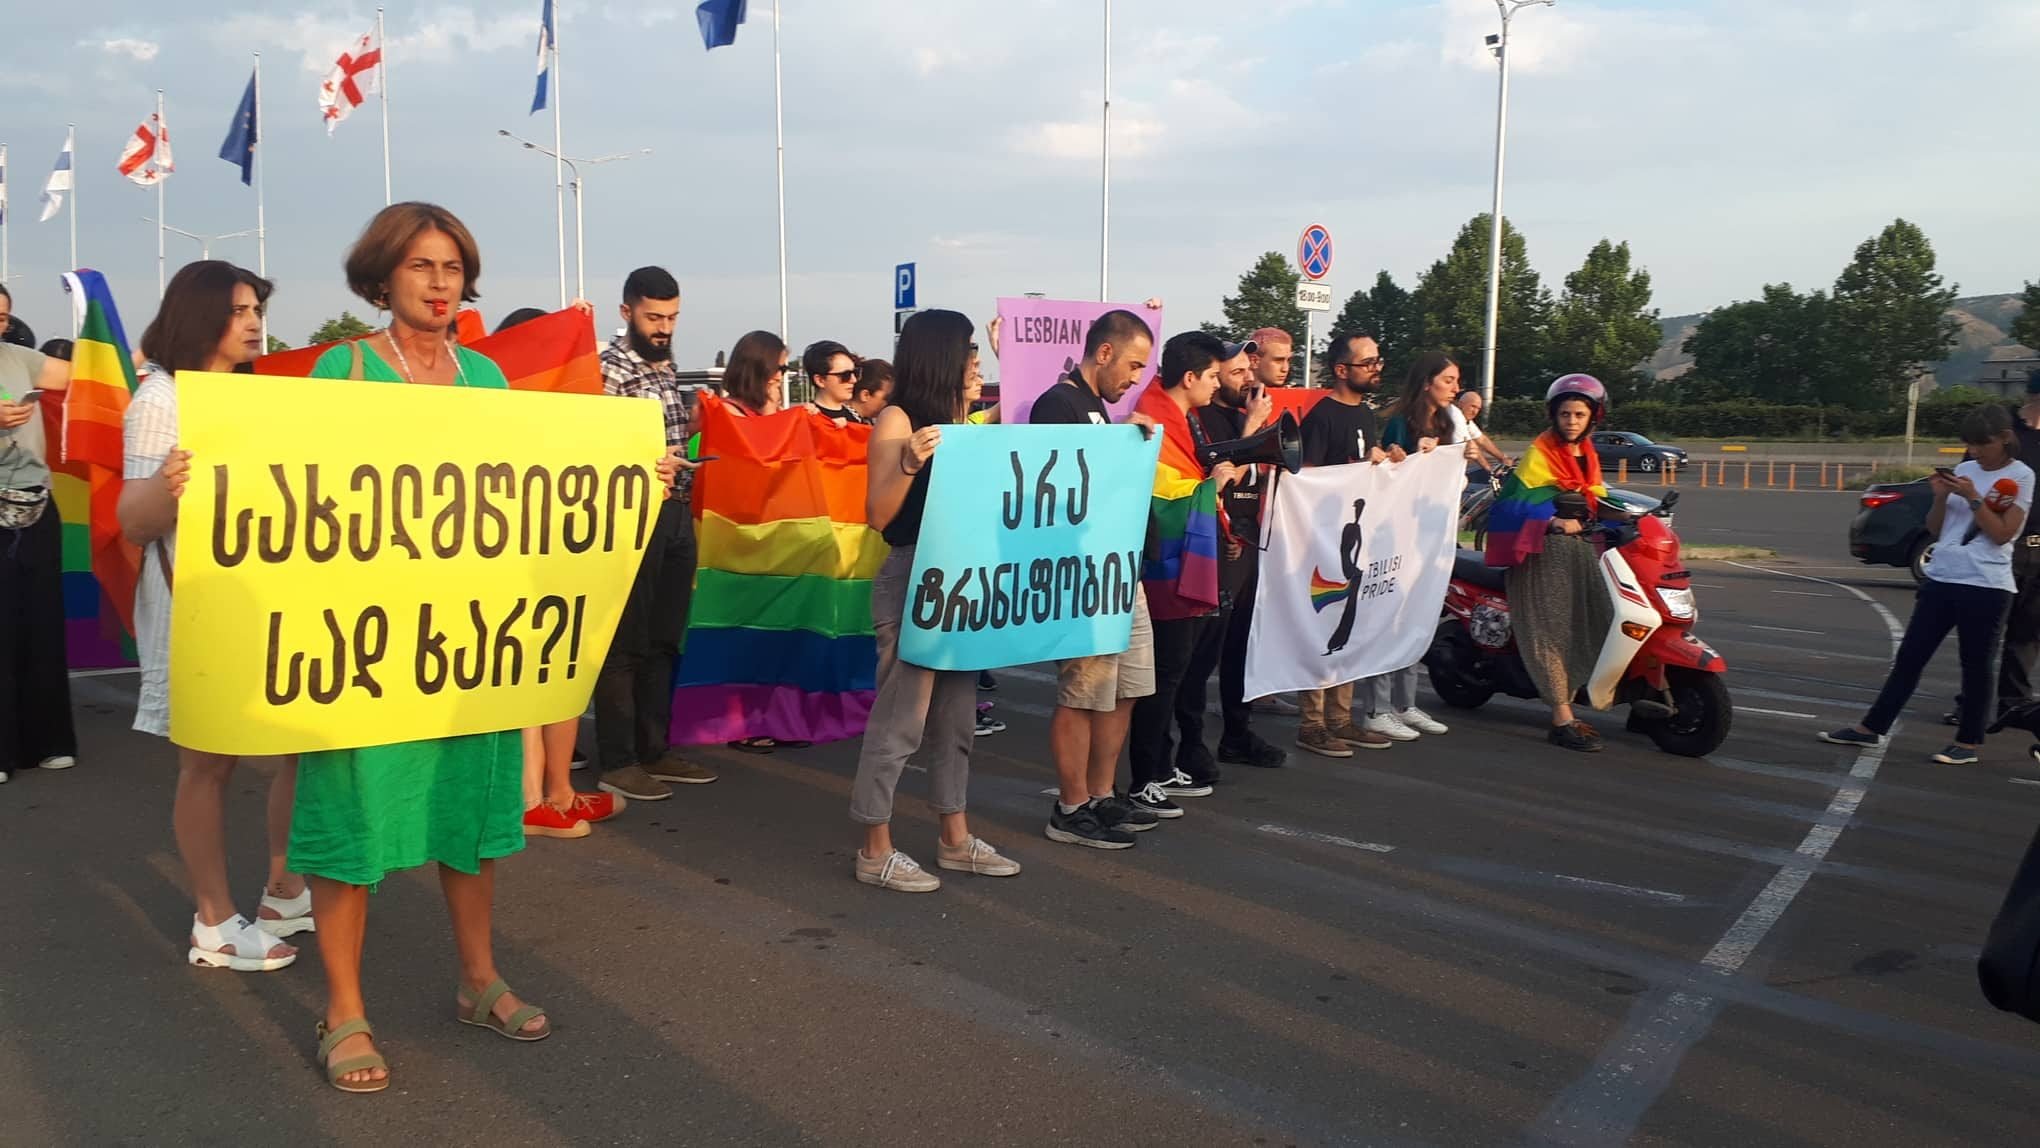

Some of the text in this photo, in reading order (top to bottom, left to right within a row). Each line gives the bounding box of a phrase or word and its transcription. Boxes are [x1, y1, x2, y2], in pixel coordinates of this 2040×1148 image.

[899, 269, 911, 304] P
[1014, 316, 1082, 344] LESBIAN
[212, 462, 650, 567] სახელმწიფო
[1003, 448, 1089, 530] არა
[911, 550, 1143, 632] ტრანსფობია
[1361, 577, 1396, 601] PRIDE
[1368, 555, 1402, 579] TBILISI
[265, 594, 586, 706] სად ხარ?!
